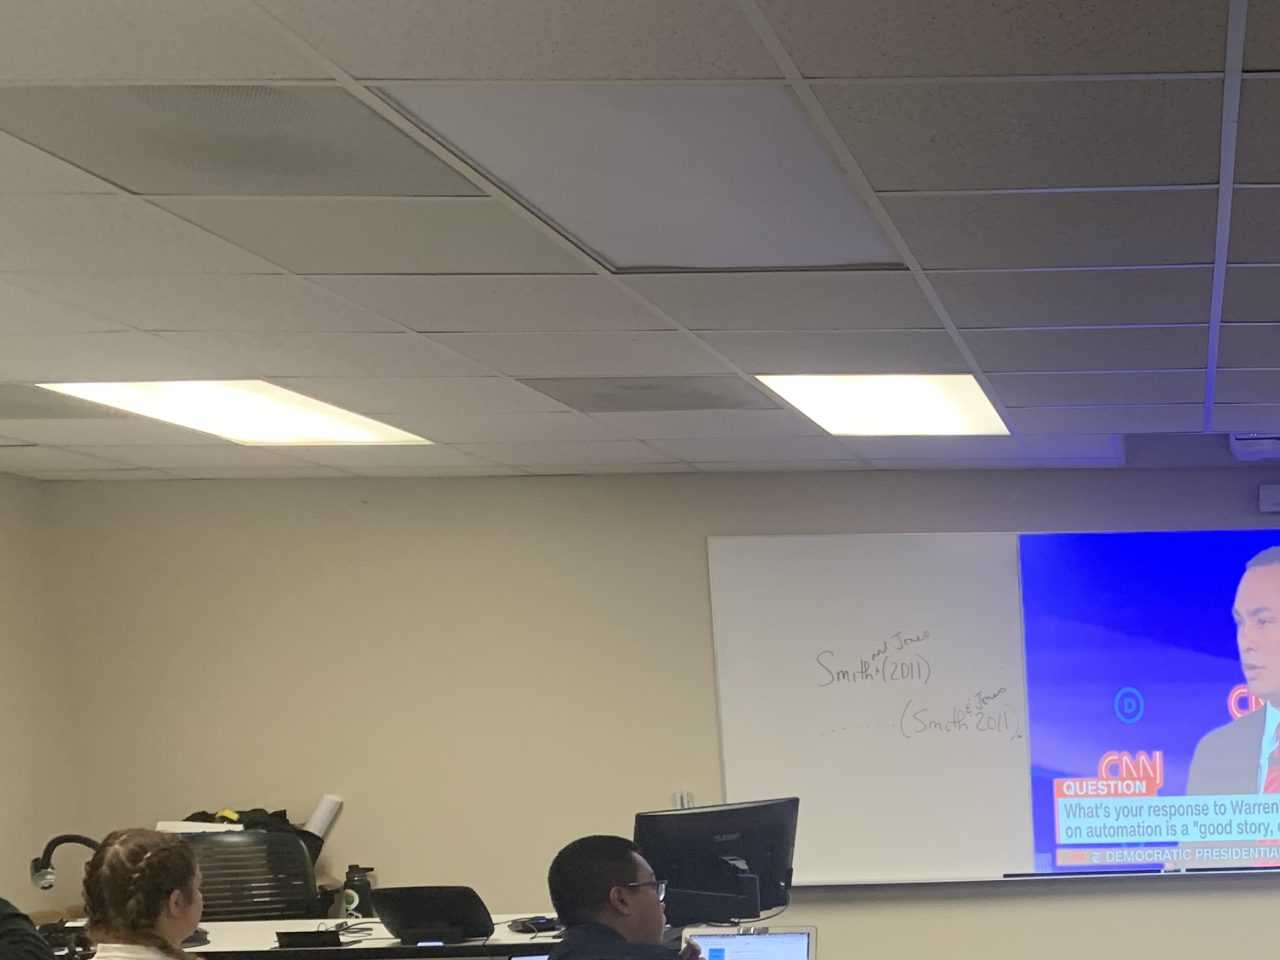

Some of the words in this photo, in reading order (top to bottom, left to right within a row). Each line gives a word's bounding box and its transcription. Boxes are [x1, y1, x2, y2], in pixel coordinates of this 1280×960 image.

[882, 653, 931, 685] (2011)
[1099, 751, 1164, 788] CNN
[1063, 780, 1147, 796] QUESTION
[1064, 803, 1110, 819] What's
[1114, 806, 1144, 821] your
[1147, 802, 1209, 821] response
[1214, 801, 1227, 815] to
[1066, 826, 1083, 839] on
[1086, 822, 1162, 838] automation
[1165, 823, 1177, 836] is
[1181, 824, 1190, 836] a
[1193, 820, 1233, 838] "good
[1236, 820, 1274, 838] story,
[1105, 847, 1192, 864] DEMOCRATIC
